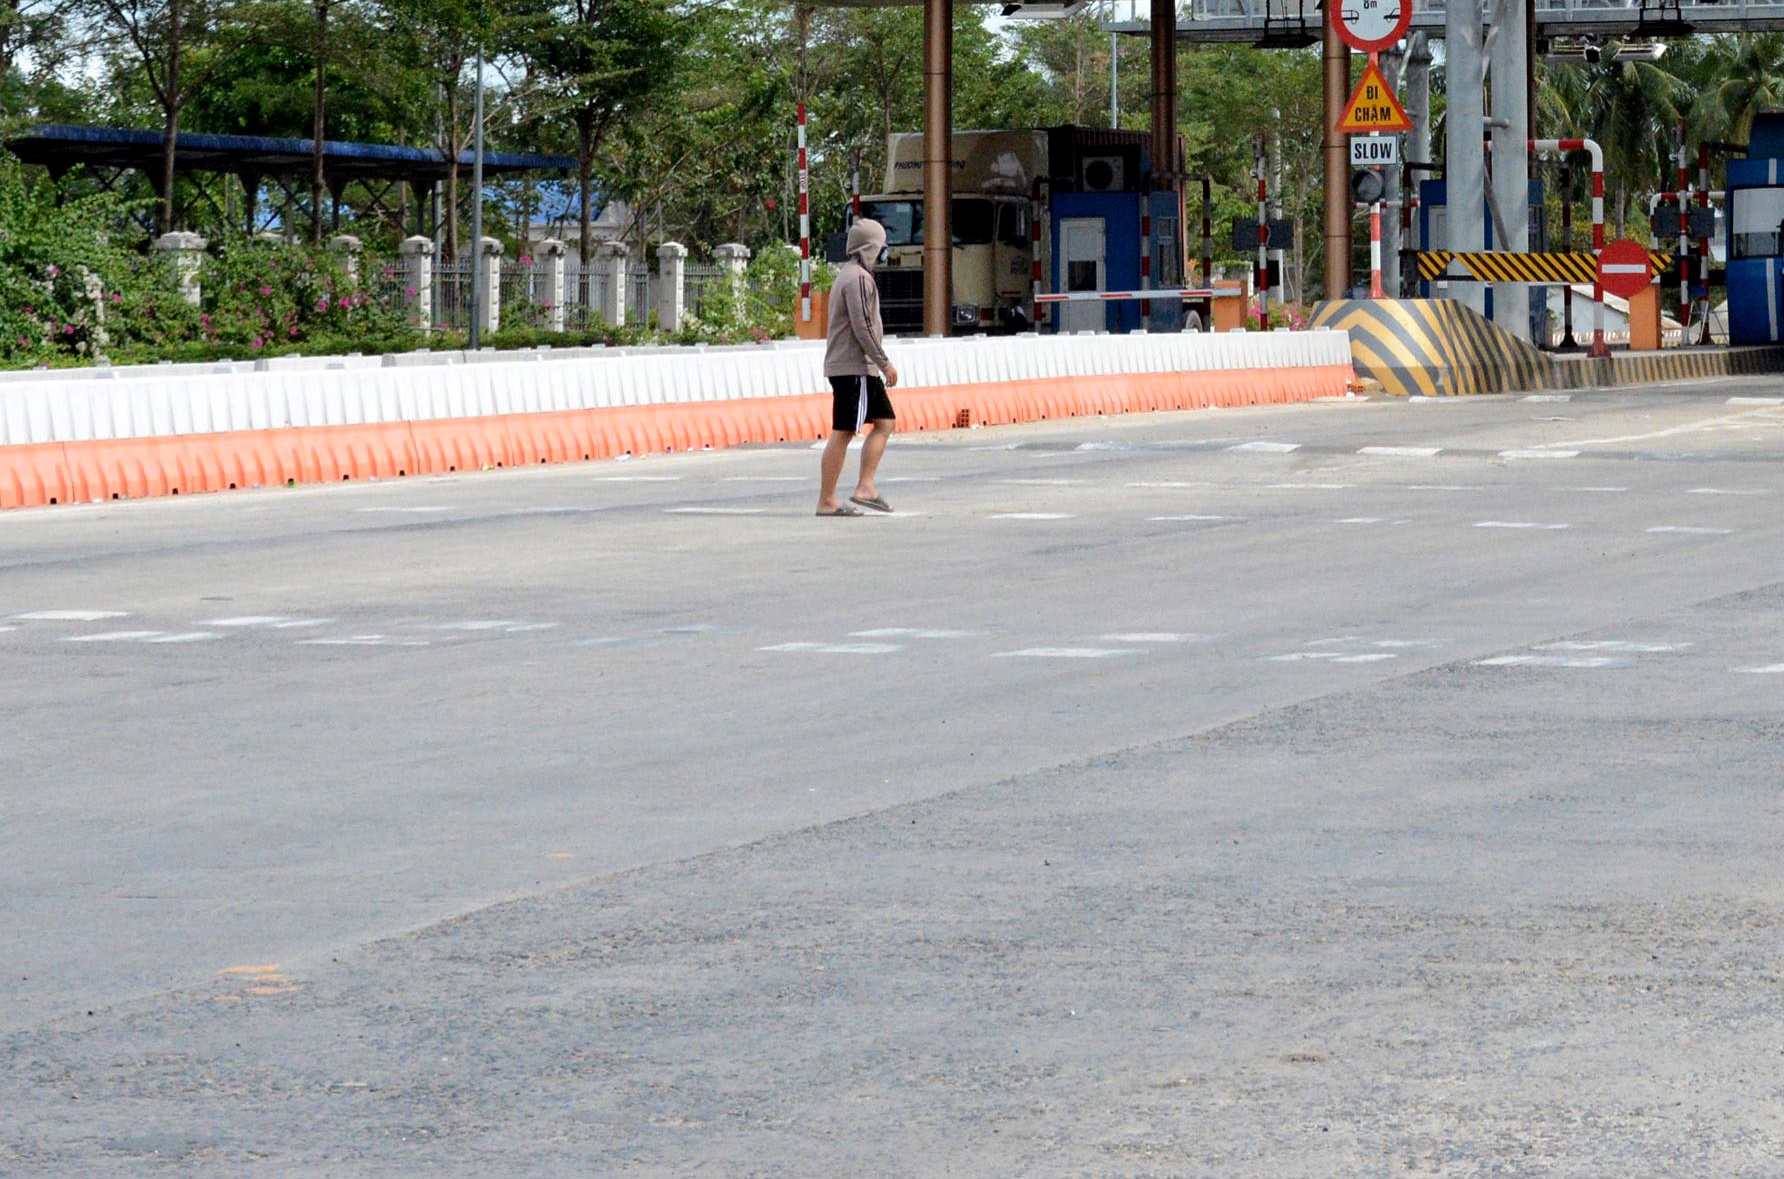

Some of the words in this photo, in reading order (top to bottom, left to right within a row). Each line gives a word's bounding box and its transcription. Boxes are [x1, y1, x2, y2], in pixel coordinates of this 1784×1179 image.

[1366, 85, 1378, 100] ĐI
[1354, 104, 1392, 126] CHẬM
[1354, 142, 1393, 160] SLOW
